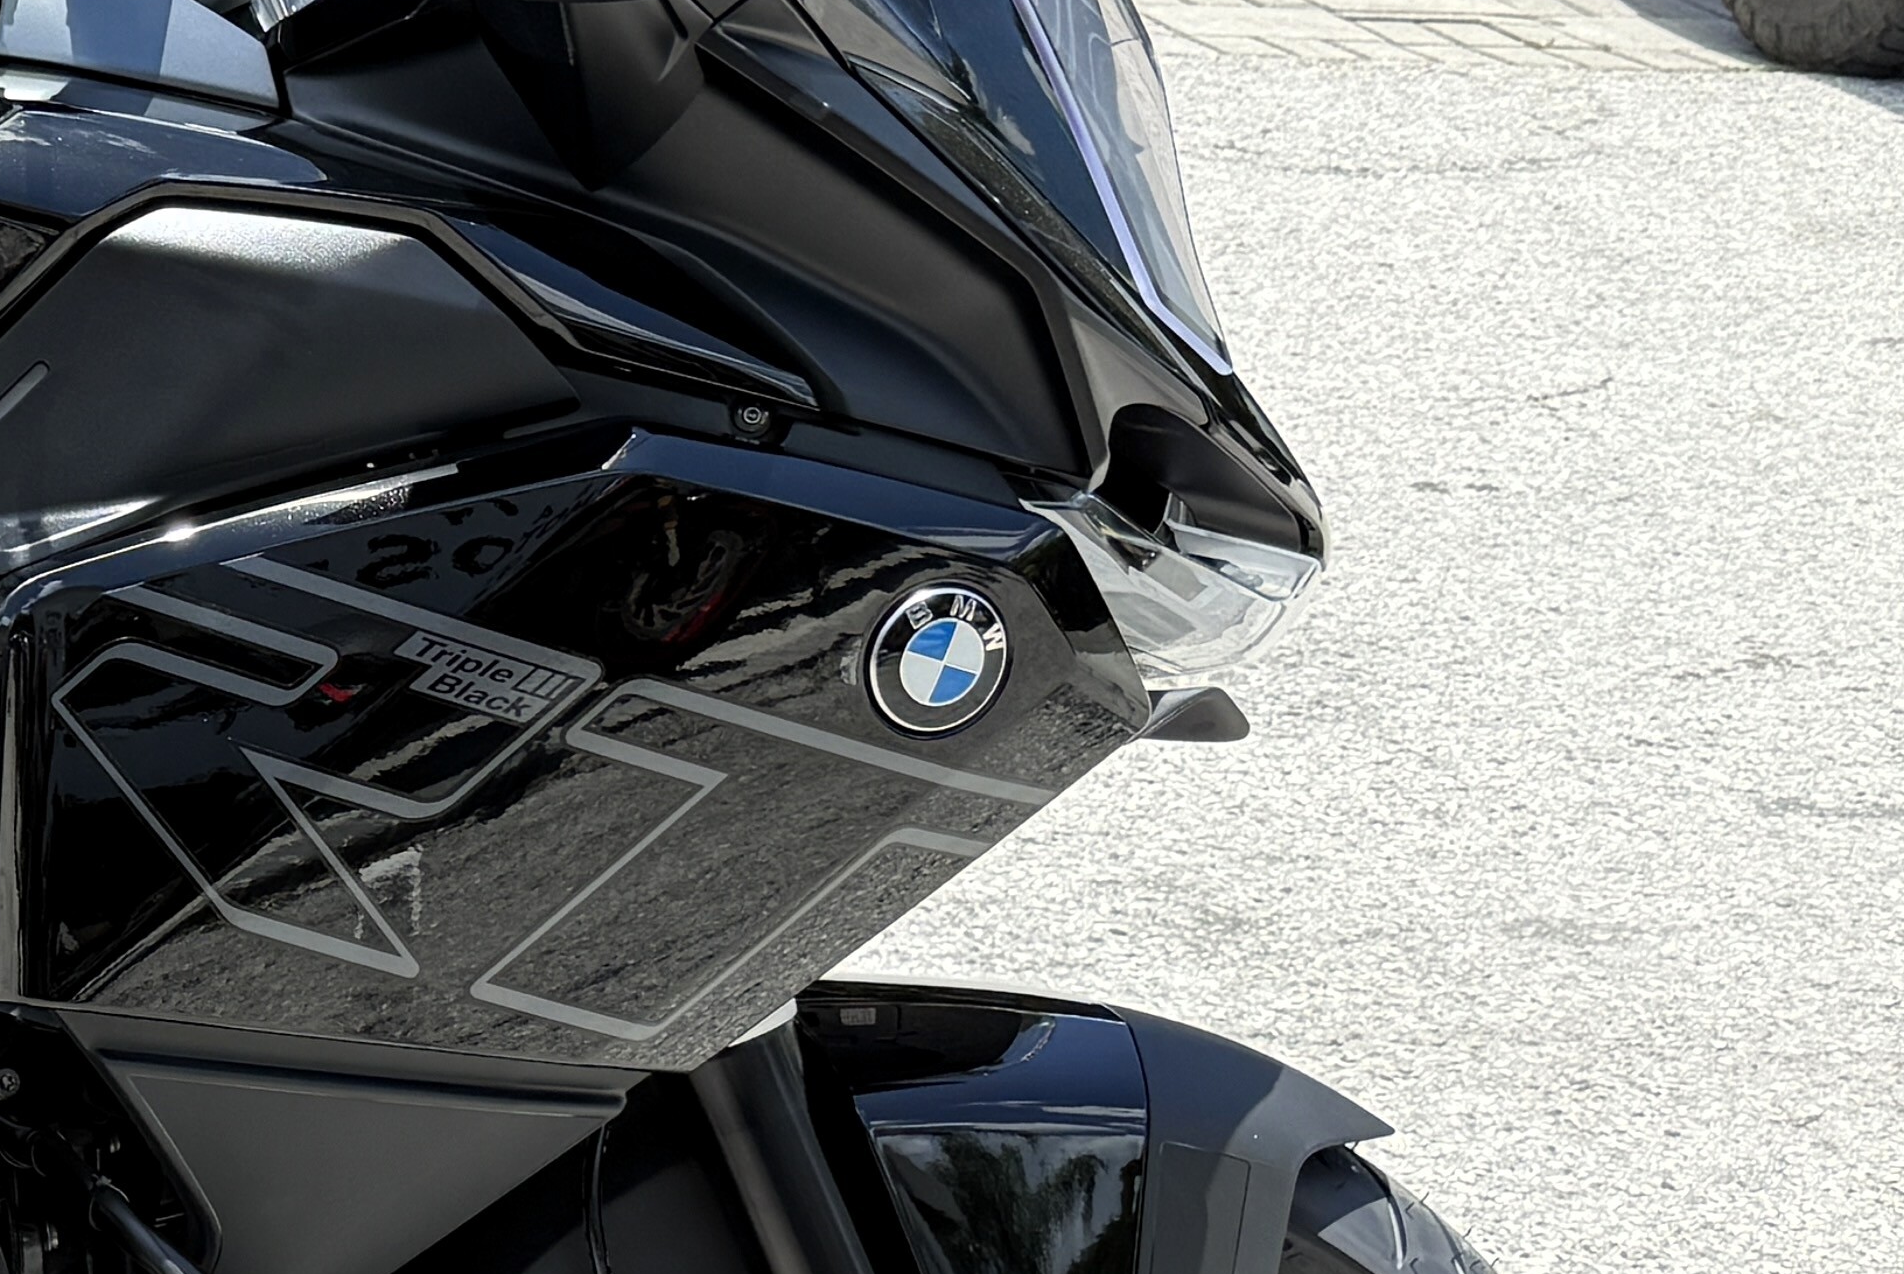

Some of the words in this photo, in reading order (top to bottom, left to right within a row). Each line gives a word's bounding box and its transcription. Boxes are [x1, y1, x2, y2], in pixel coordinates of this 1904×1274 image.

[905, 594, 1005, 652] BMW
[415, 637, 515, 685] Triple
[427, 674, 532, 718] Black
